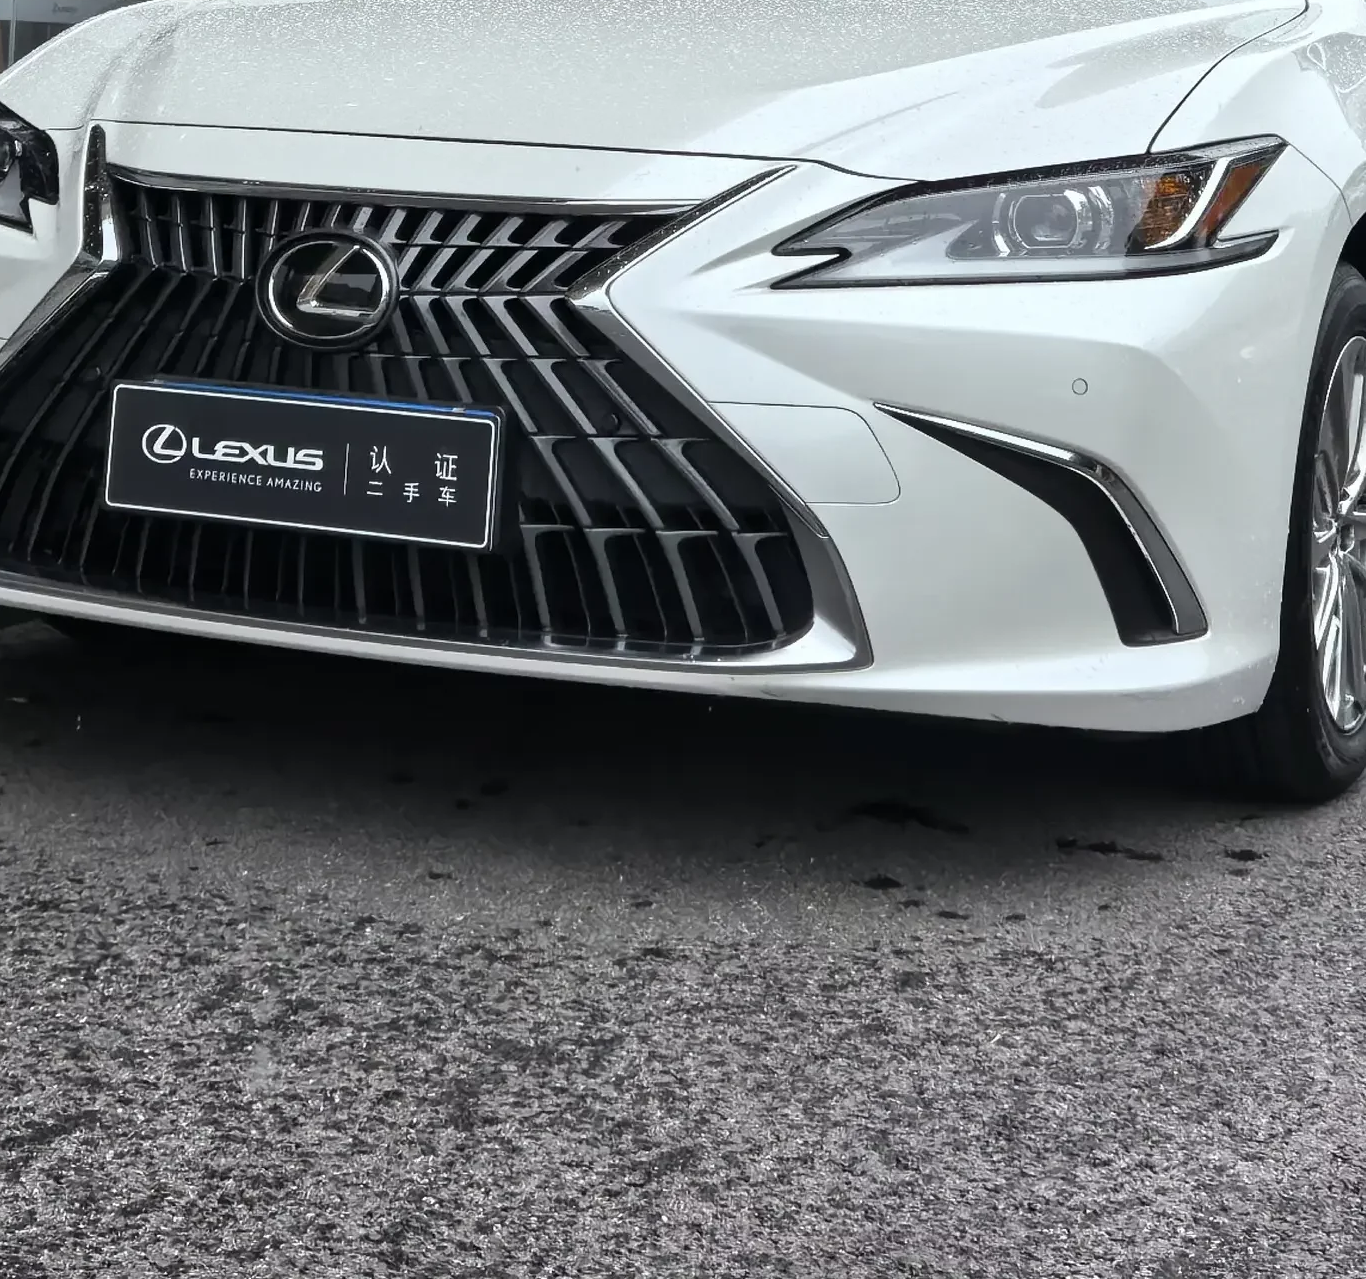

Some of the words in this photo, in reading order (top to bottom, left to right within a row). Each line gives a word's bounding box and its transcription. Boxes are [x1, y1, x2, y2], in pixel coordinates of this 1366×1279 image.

[191, 436, 324, 471] LEXUS
[189, 468, 262, 487] EXPERIENCE
[266, 476, 323, 493] AMAZING
